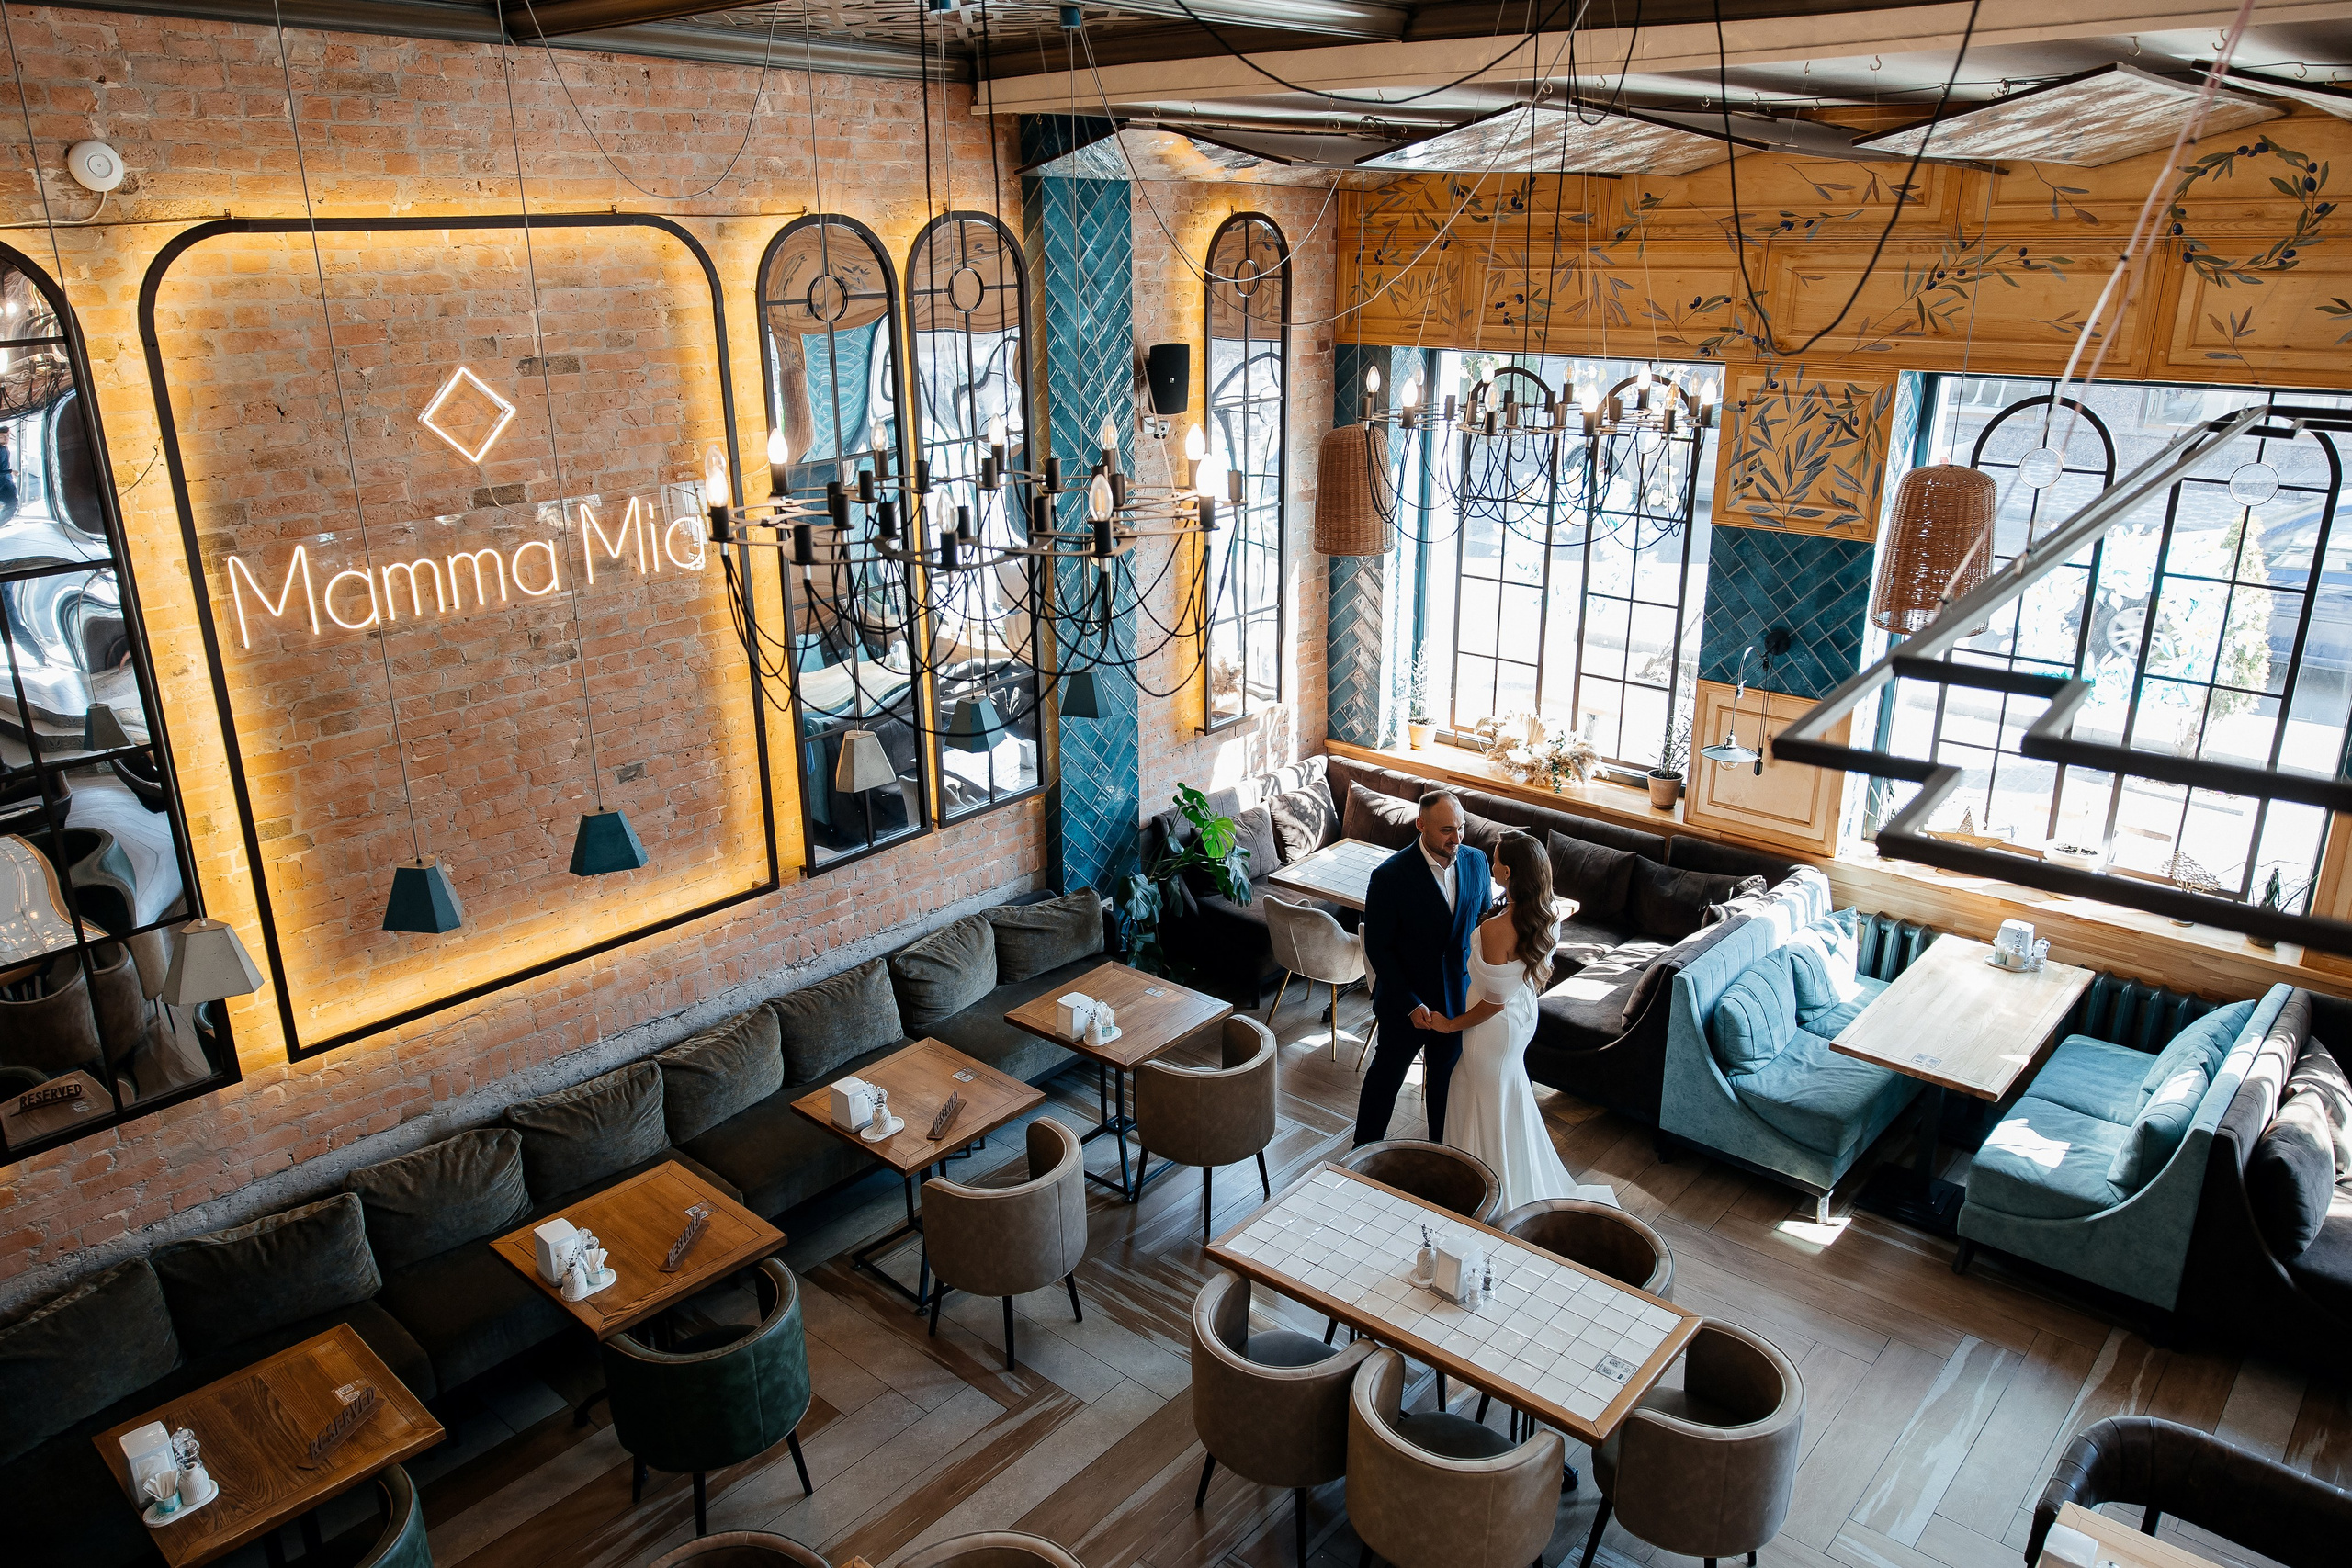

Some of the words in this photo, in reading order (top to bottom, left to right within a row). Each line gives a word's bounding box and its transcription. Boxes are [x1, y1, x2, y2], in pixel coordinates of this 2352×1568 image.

[227, 538, 560, 649] Mamma
[579, 495, 706, 585] Mia
[19, 1083, 83, 1110] RESERVED
[308, 1385, 377, 1461] RESERVED
